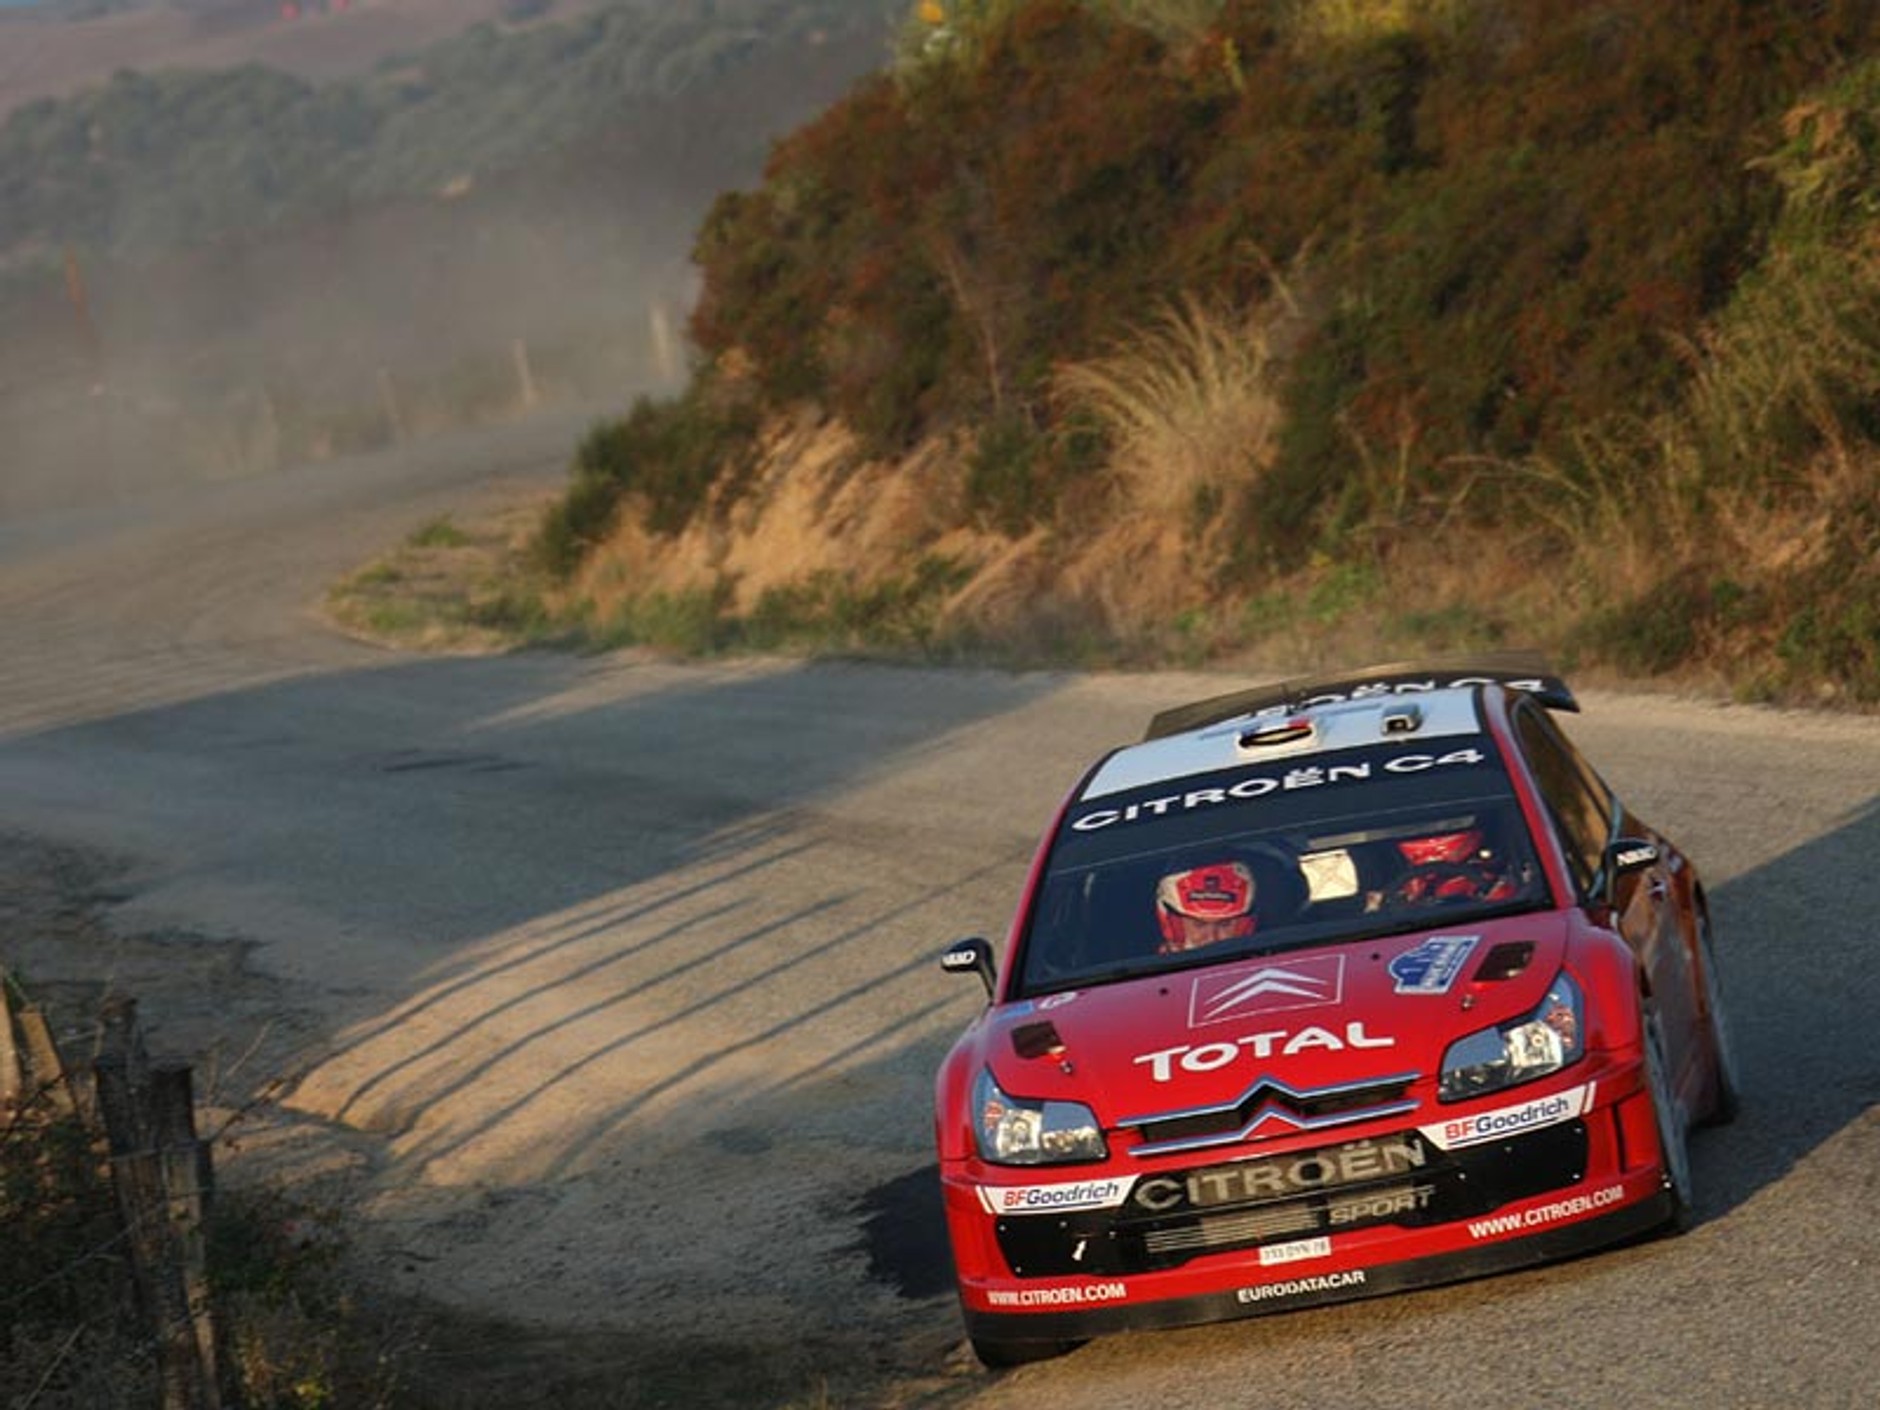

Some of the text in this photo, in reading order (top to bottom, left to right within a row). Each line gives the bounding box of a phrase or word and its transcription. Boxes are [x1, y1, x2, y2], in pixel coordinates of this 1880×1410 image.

[1071, 749, 1486, 830] CITROËN C4
[1132, 1022, 1395, 1081] TOTAL
[1444, 1097, 1569, 1139] BFGoodrich
[1003, 1182, 1119, 1207] BFGoodrich
[1133, 1139, 1427, 1210] CITROËN
[1328, 1184, 1436, 1224] SPORT
[1468, 1185, 1625, 1239] WWW.CITROEN.COM
[1237, 1269, 1366, 1303] EURODATACAR
